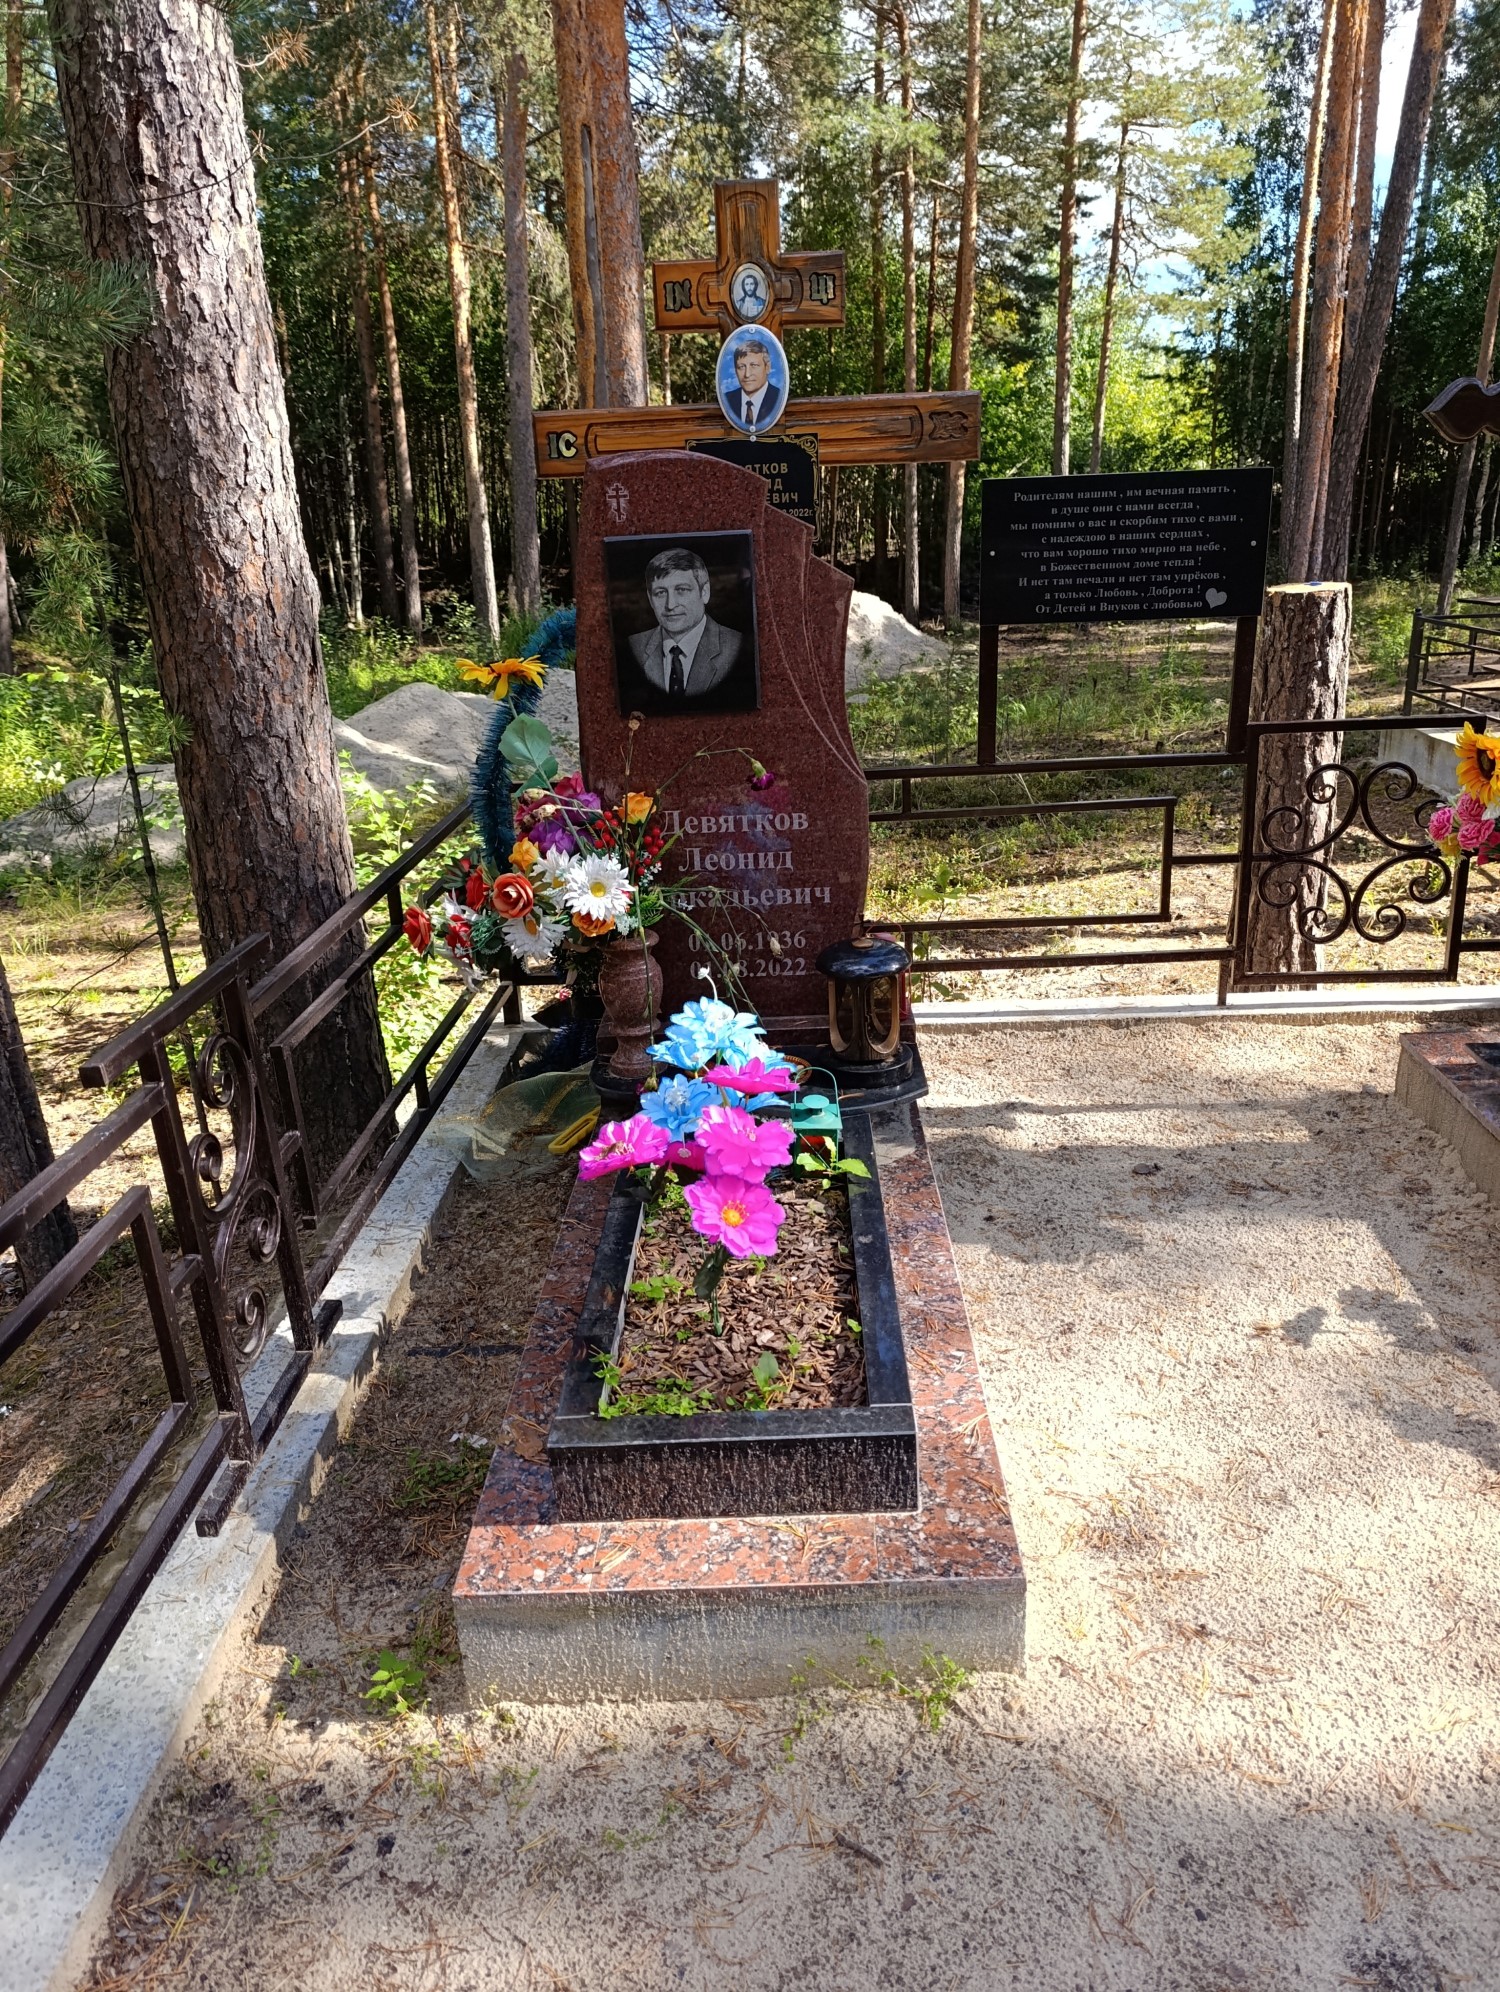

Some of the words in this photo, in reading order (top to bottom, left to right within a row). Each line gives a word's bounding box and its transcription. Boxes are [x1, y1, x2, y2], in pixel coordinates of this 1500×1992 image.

[1014, 492, 1074, 502] Родителям
[1077, 490, 1117, 499] нашим
[1126, 489, 1142, 497] им
[1145, 487, 1185, 496] вечная
[1188, 486, 1230, 494] память
[1061, 505, 1090, 516] душе
[1092, 505, 1113, 513] они
[1125, 503, 1154, 512] нами
[1157, 501, 1194, 510] всегда
[1010, 523, 1028, 531] мы
[1031, 521, 1076, 530] помним
[1088, 519, 1107, 528] вас
[1119, 515, 1168, 528] скорбим
[1170, 515, 1197, 524] тихо
[1208, 514, 1237, 523] вами
[1050, 534, 1106, 544] надеждою
[1119, 531, 1156, 540] наших
[1159, 530, 1204, 541] сердцах
[1021, 551, 1040, 559] что
[1043, 549, 1064, 558] вам
[1067, 548, 1109, 559] хорошо
[1112, 547, 1137, 555] тихо
[1140, 545, 1176, 556] мирно
[1179, 544, 1193, 552] на
[1195, 541, 1221, 552] небе
[1050, 561, 1130, 572] Божественном
[1133, 559, 1160, 569] доме
[1163, 558, 1195, 567] тепла
[1031, 577, 1050, 586] нет
[1053, 576, 1073, 585] там
[1076, 575, 1115, 584] печали
[1129, 574, 1148, 582] нет
[1150, 573, 1171, 582] там
[1174, 571, 1220, 582] упрёков
[1053, 590, 1092, 599] только
[1094, 587, 1138, 598] Любовь
[1147, 585, 1194, 597] Доброта
[1035, 603, 1051, 614] От
[1053, 602, 1086, 614] Детей
[1099, 602, 1140, 613] Внуков
[1151, 599, 1203, 609] любовью
[660, 810, 809, 839] Девятков
[679, 847, 794, 872] Леонид
